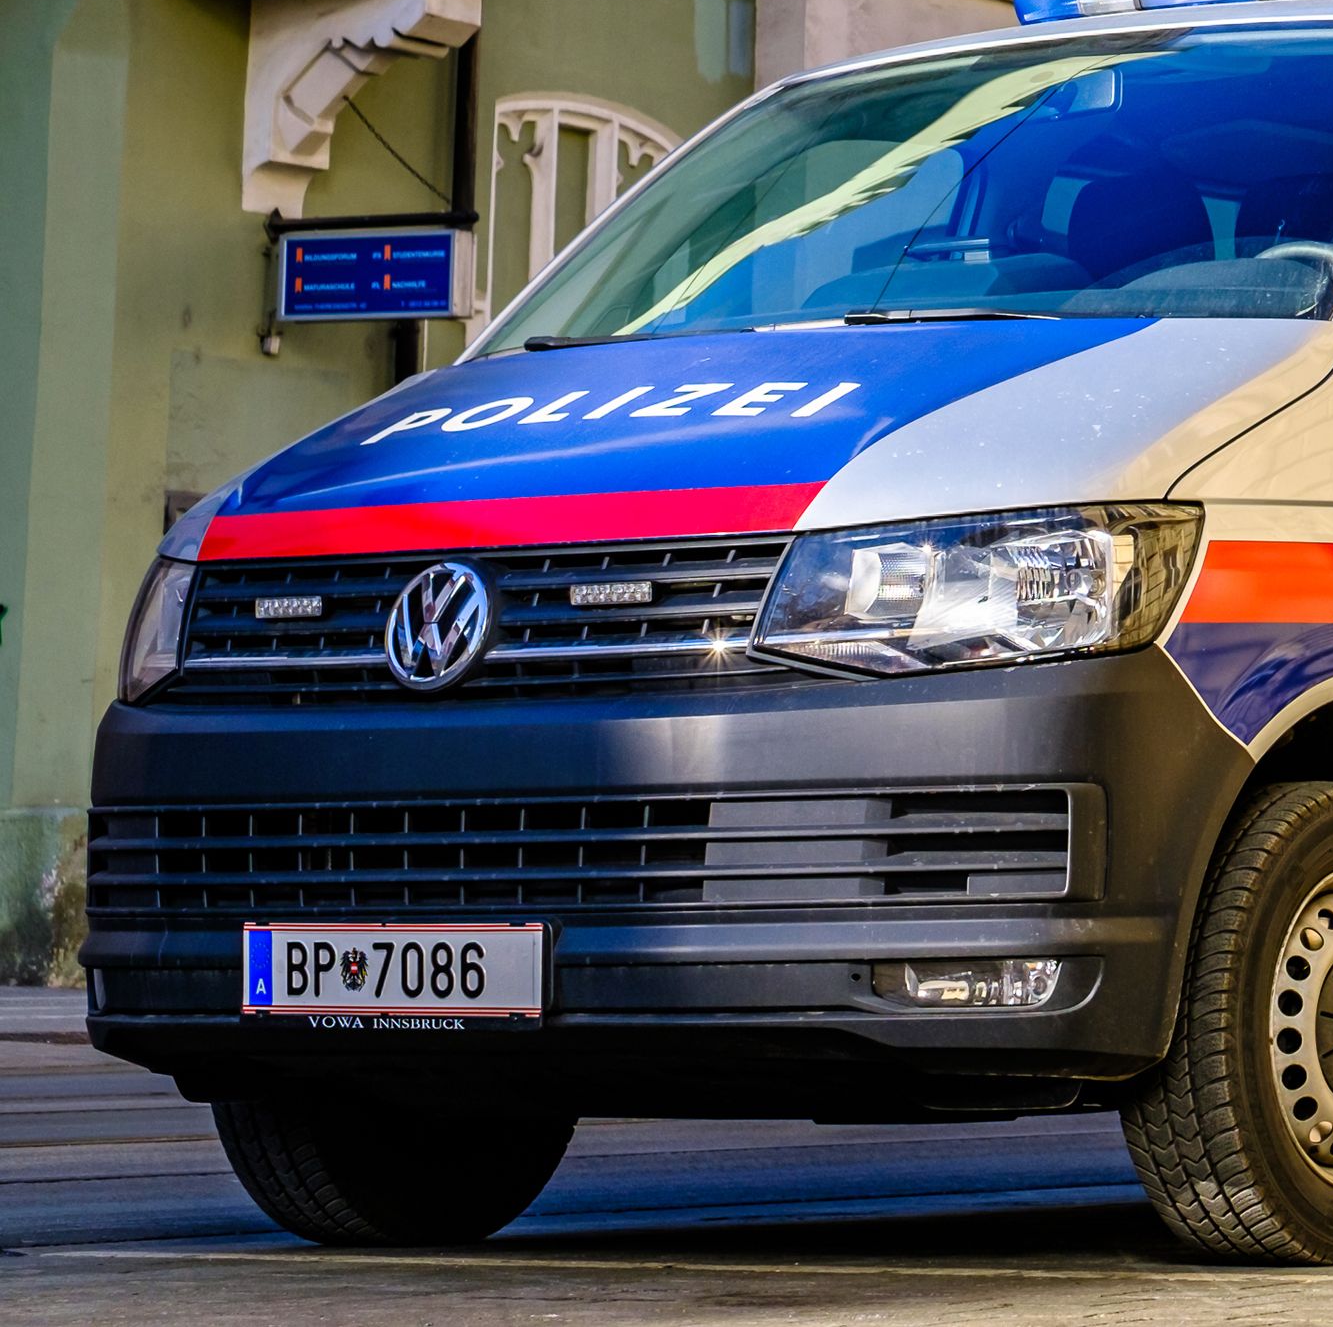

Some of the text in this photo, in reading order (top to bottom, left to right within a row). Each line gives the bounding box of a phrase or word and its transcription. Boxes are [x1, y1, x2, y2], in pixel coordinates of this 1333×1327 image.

[360, 382, 861, 445] POLIZEI
[256, 978, 266, 994] A
[286, 941, 486, 999] BP 7086
[308, 1016, 465, 1030] VOWA INNSBRUCK
